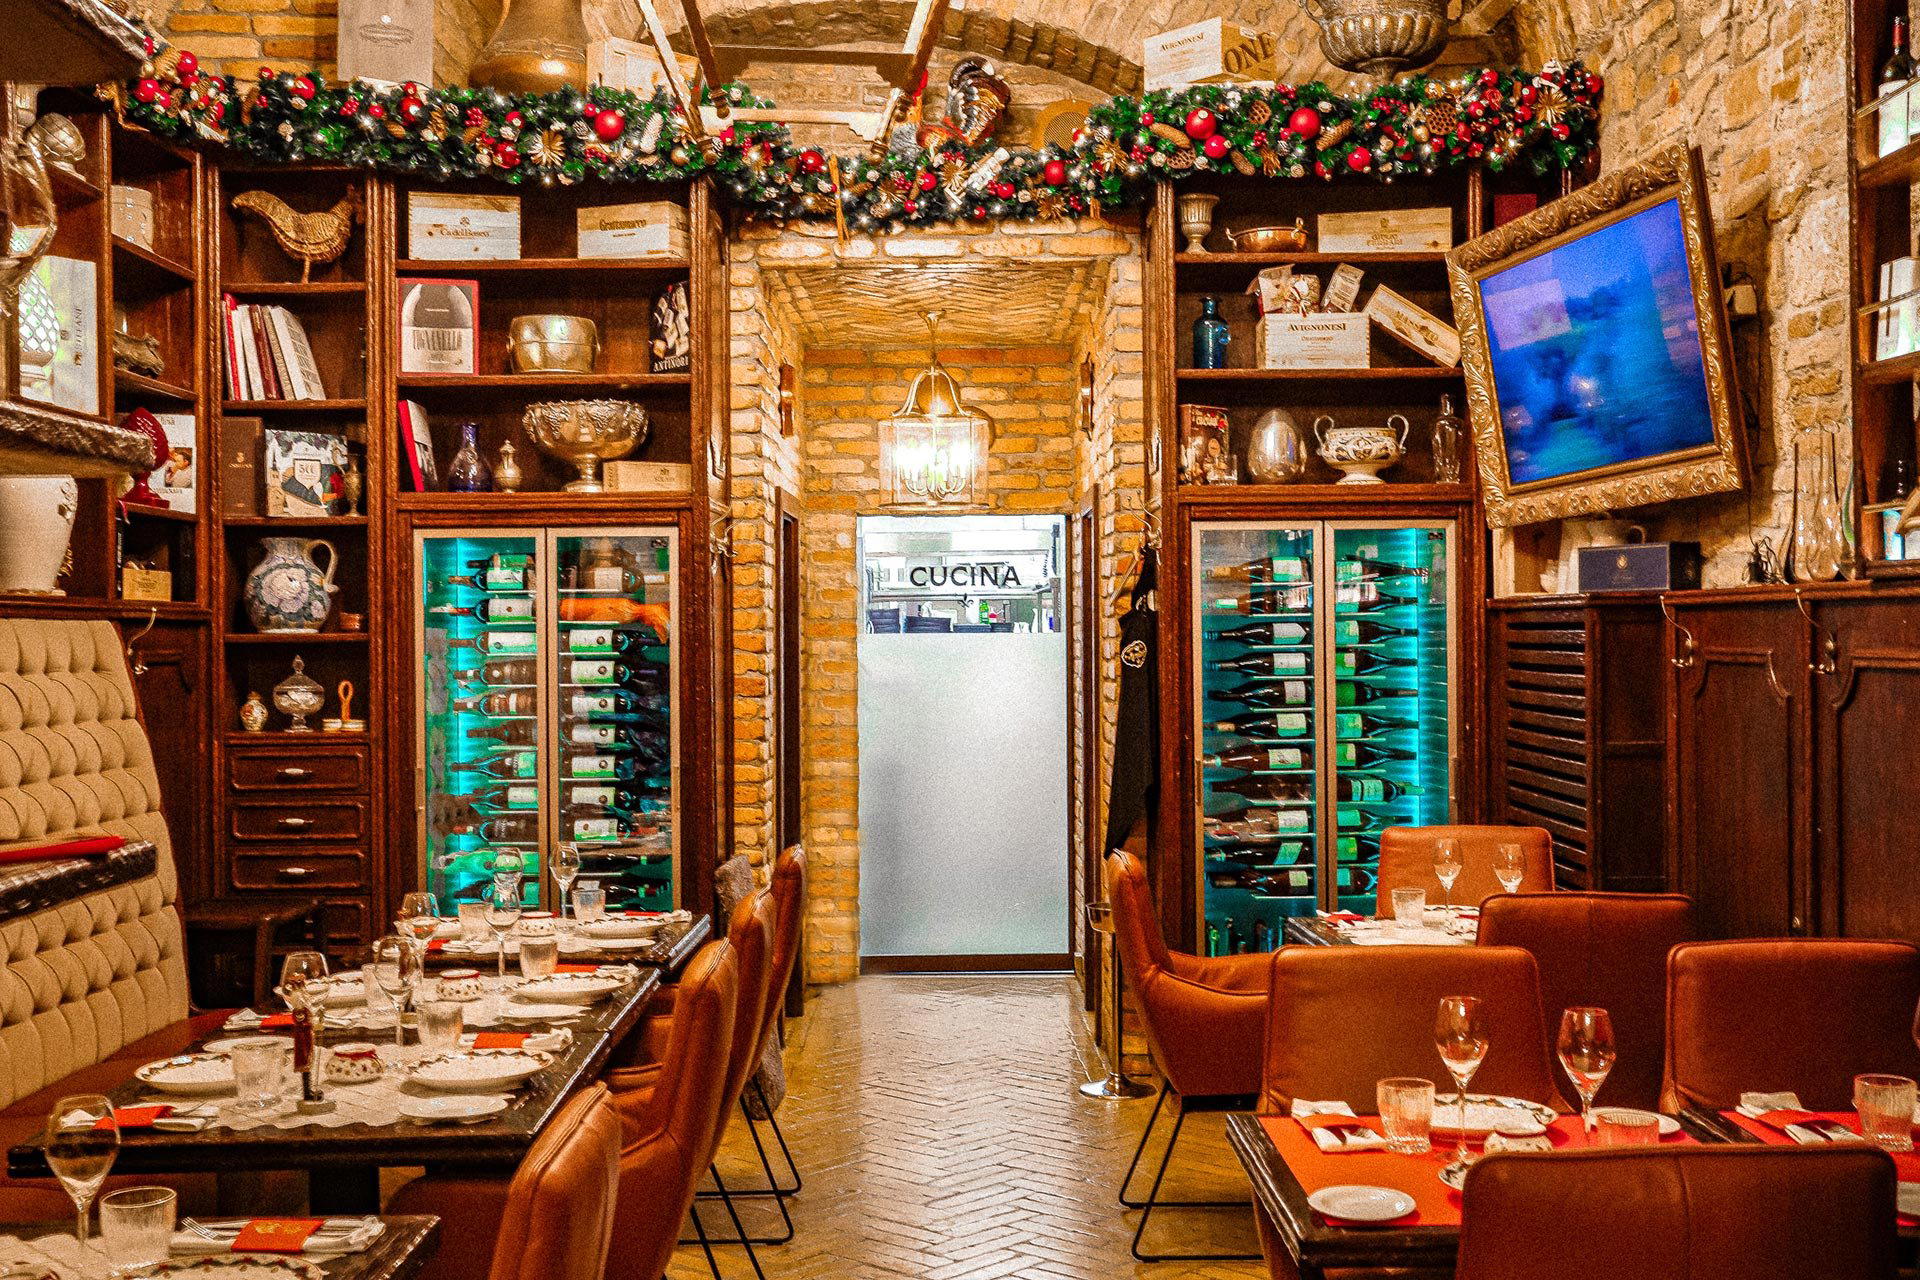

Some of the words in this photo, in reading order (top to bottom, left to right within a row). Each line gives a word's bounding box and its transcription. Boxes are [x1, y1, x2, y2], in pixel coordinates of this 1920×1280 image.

[1288, 322, 1347, 332] AVIGNONESI
[653, 356, 689, 372] ANTINORI
[910, 565, 1021, 587] CUCINA
